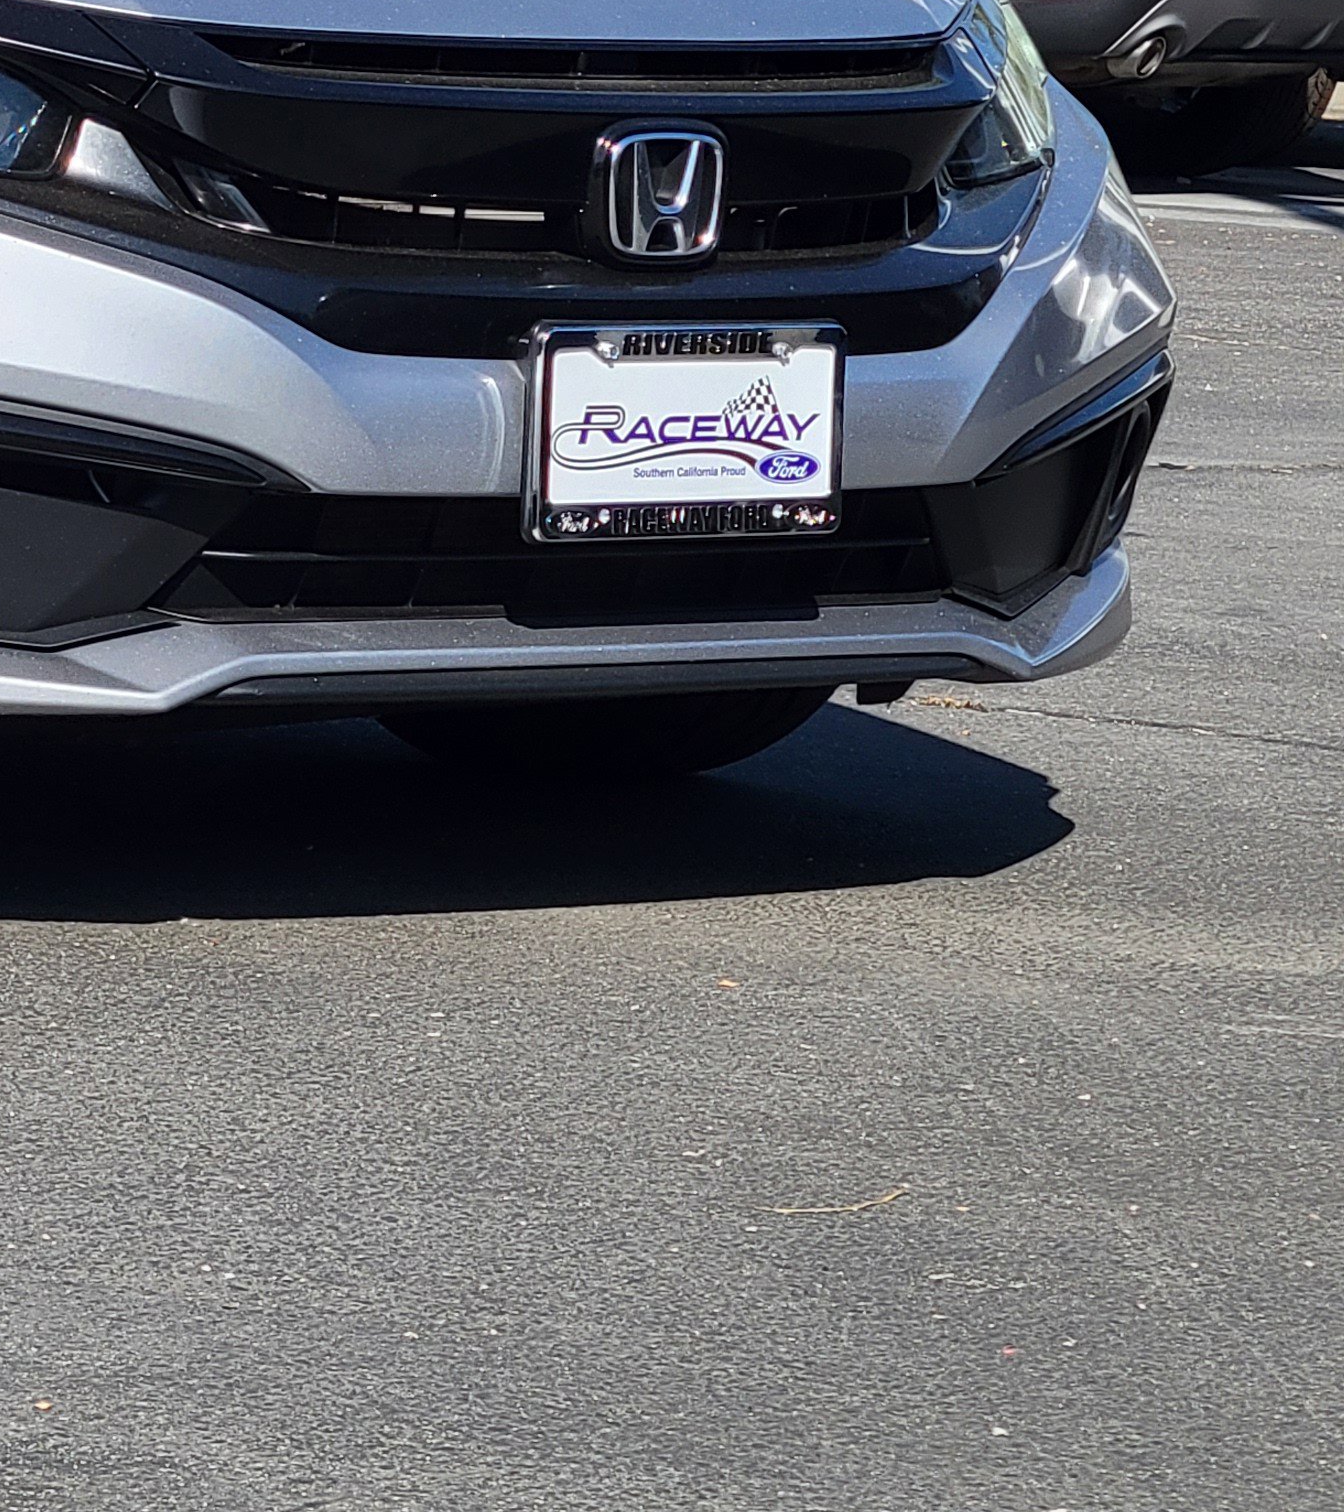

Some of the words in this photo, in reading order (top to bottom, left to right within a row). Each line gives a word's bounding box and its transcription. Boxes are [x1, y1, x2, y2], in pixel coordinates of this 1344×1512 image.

[622, 331, 774, 356] RIVERSIDE
[577, 405, 821, 445] RACEWAY
[632, 467, 675, 479] Southern
[676, 466, 719, 478] California
[720, 465, 747, 477] Proud
[767, 456, 809, 480] Ford
[612, 505, 710, 535] RACEWAY
